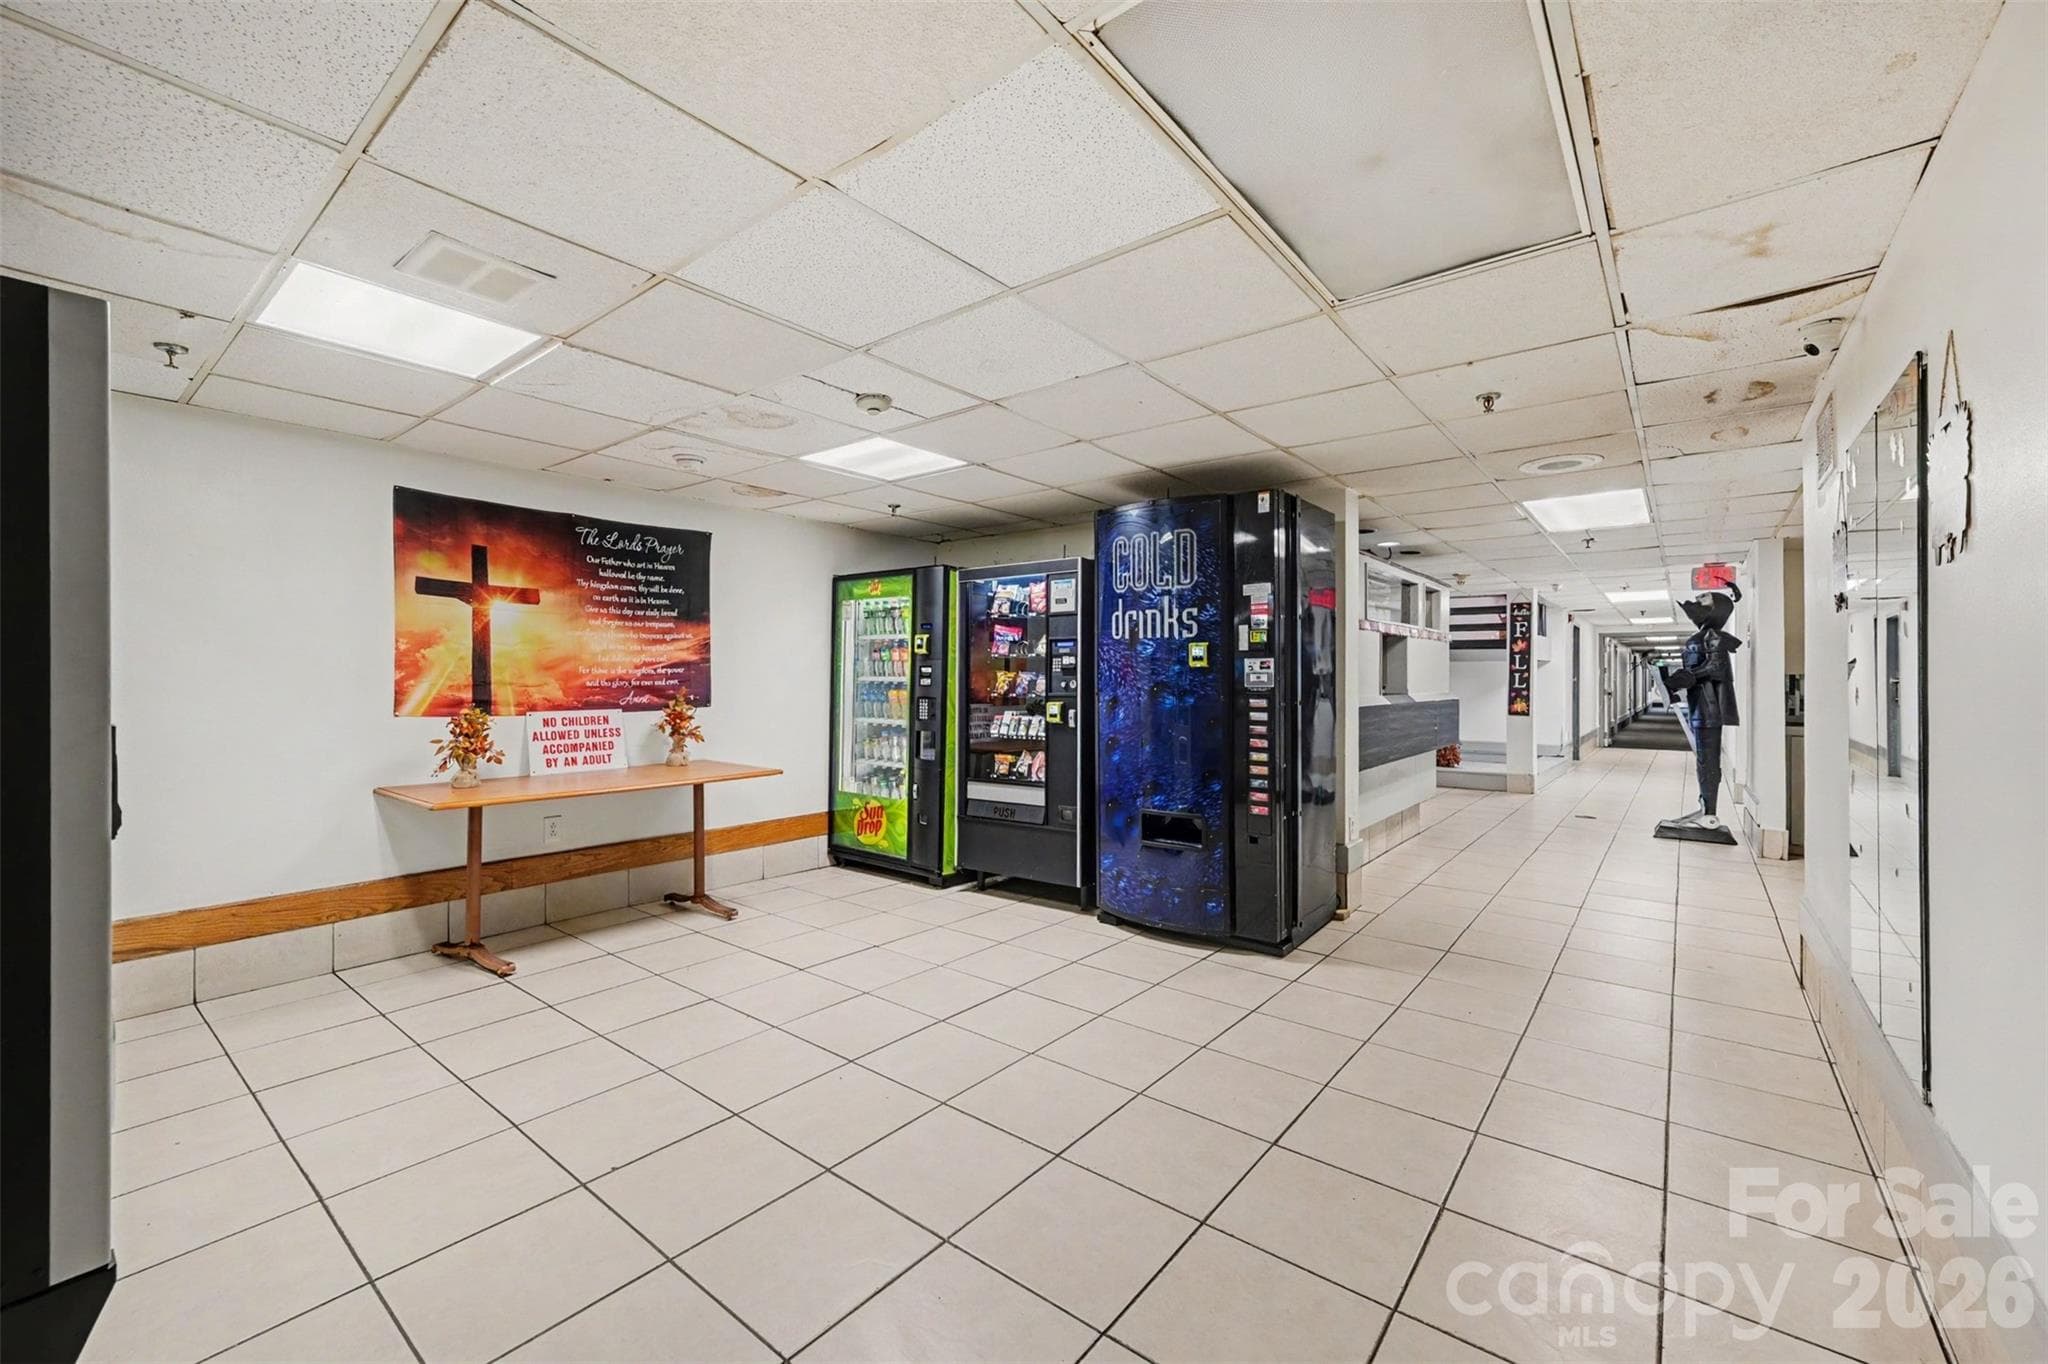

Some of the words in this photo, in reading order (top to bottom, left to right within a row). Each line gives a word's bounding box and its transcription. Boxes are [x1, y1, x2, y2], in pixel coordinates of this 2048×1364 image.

[576, 527, 599, 545] The
[602, 532, 642, 551] Lords
[644, 537, 685, 563] Prayer
[1112, 528, 1197, 593] COLD
[1111, 595, 1199, 641] drinks
[542, 718, 557, 728] NO
[561, 715, 609, 726] CHILDREN
[532, 729, 580, 742] ALLOWED
[584, 728, 621, 739] UNLESS
[542, 741, 614, 755] ACCOMPANIED
[546, 756, 558, 768] BY
[564, 755, 578, 766] AN
[582, 754, 612, 766] ADULT
[860, 801, 885, 820] Sun
[993, 806, 1016, 818] PUSH
[857, 820, 882, 837] Drop
